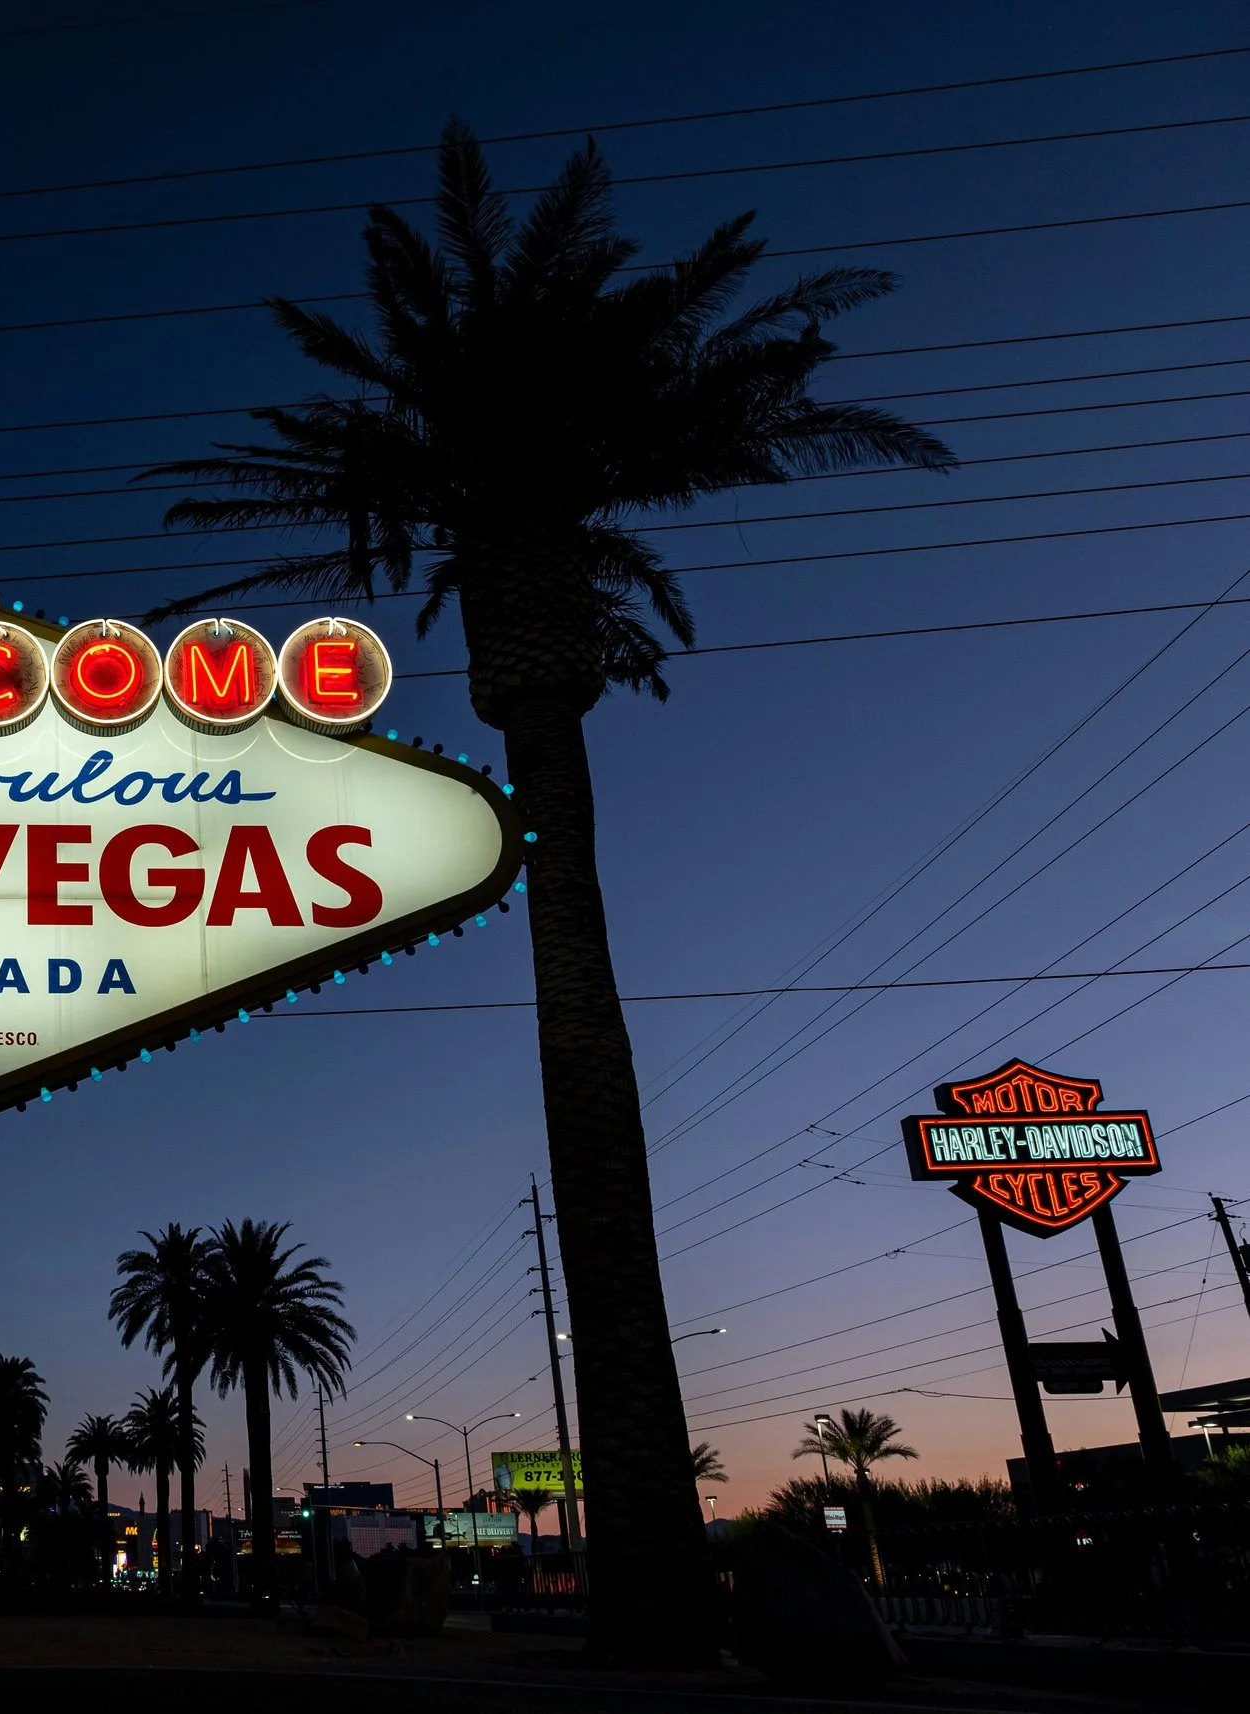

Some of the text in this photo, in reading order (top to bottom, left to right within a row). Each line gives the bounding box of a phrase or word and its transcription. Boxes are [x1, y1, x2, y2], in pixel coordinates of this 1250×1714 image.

[972, 1074, 1084, 1113] MOTOR
[931, 1123, 1144, 1161] HARLEY-DAVIDSON
[990, 1172, 1100, 1217] CYCLES
[511, 1453, 558, 1463] LERNER
[488, 1528, 514, 1536] DELIVERY
